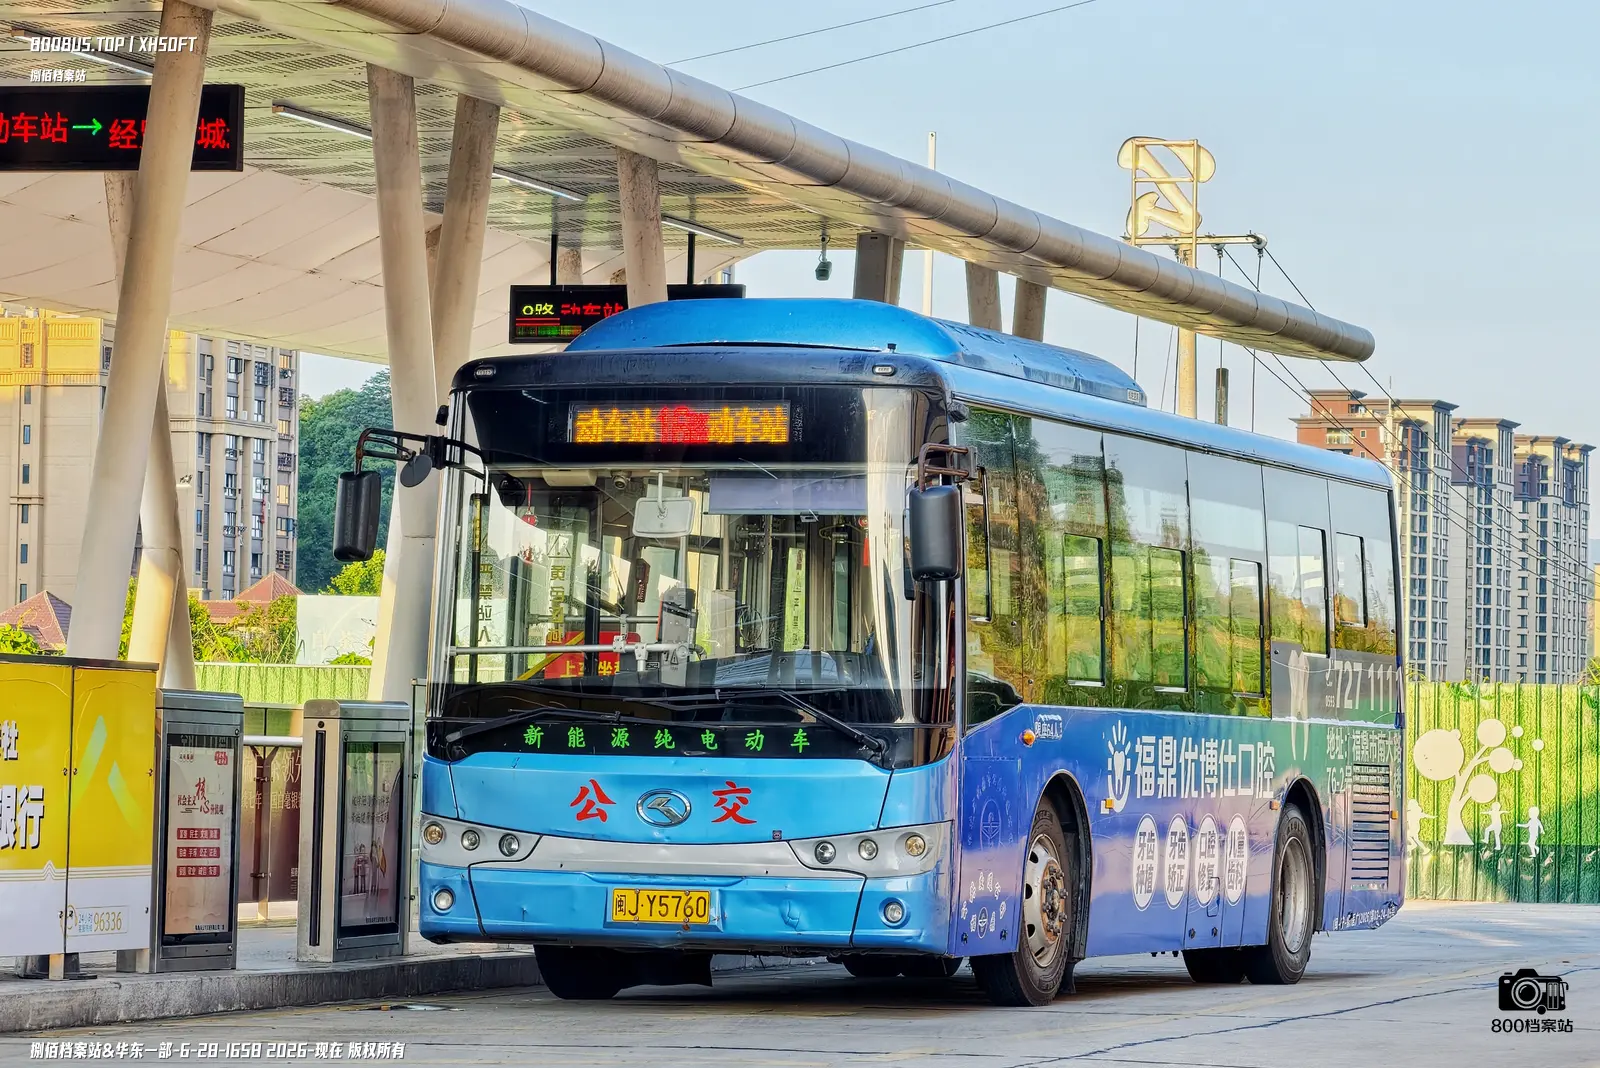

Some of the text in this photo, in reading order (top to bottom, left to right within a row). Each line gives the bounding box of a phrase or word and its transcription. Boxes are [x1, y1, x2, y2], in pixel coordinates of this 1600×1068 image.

[1332, 661, 1363, 710] 727
[523, 724, 810, 754] 新能源纯电动车
[1135, 735, 1275, 799] 福鼎优博仕口腔
[1138, 831, 1155, 860] 牙齿
[1169, 831, 1186, 860] 牙齿
[93, 911, 123, 932] 96336
